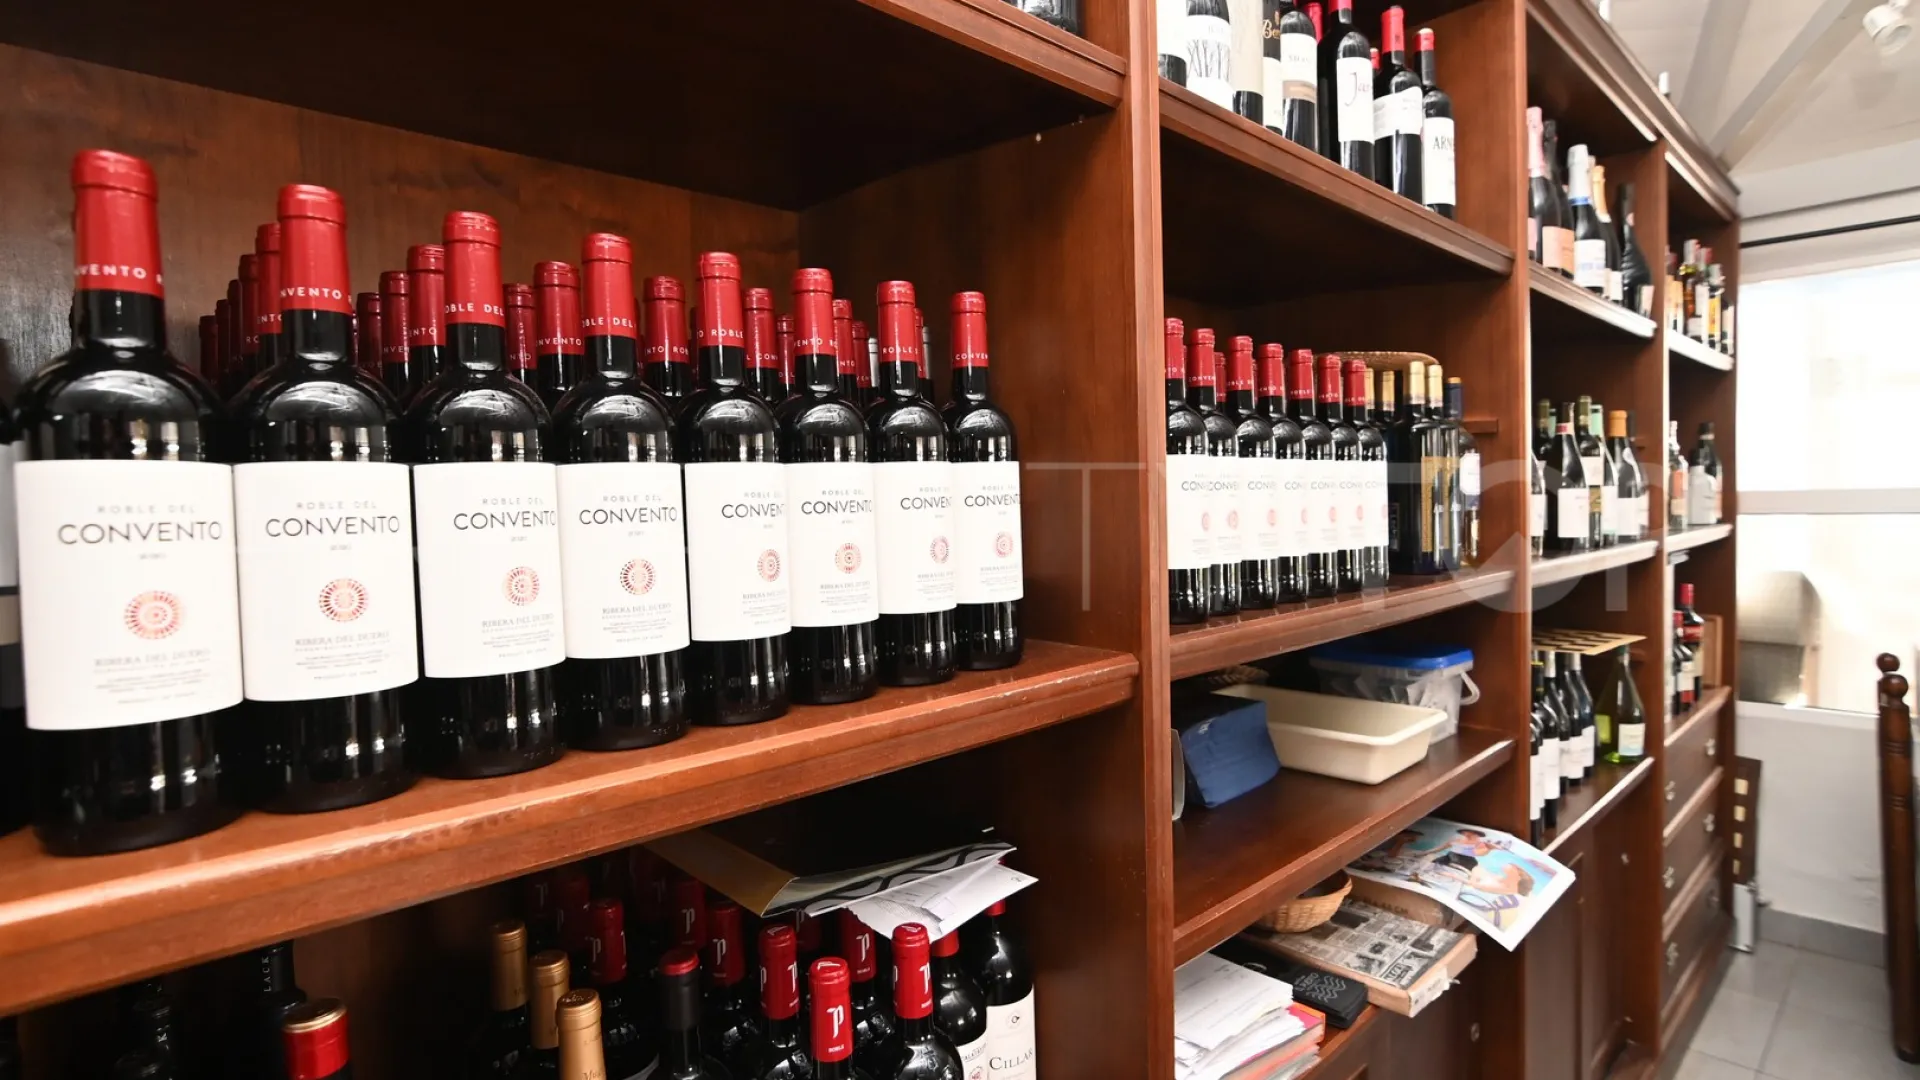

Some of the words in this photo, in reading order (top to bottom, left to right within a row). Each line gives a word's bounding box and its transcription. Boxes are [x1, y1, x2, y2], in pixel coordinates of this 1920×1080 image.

[483, 303, 504, 316] DEL
[613, 317, 633, 328] DEL
[579, 506, 678, 525] CONVENTO
[58, 521, 222, 545] CONVENTO
[265, 515, 400, 538] CONVENTO
